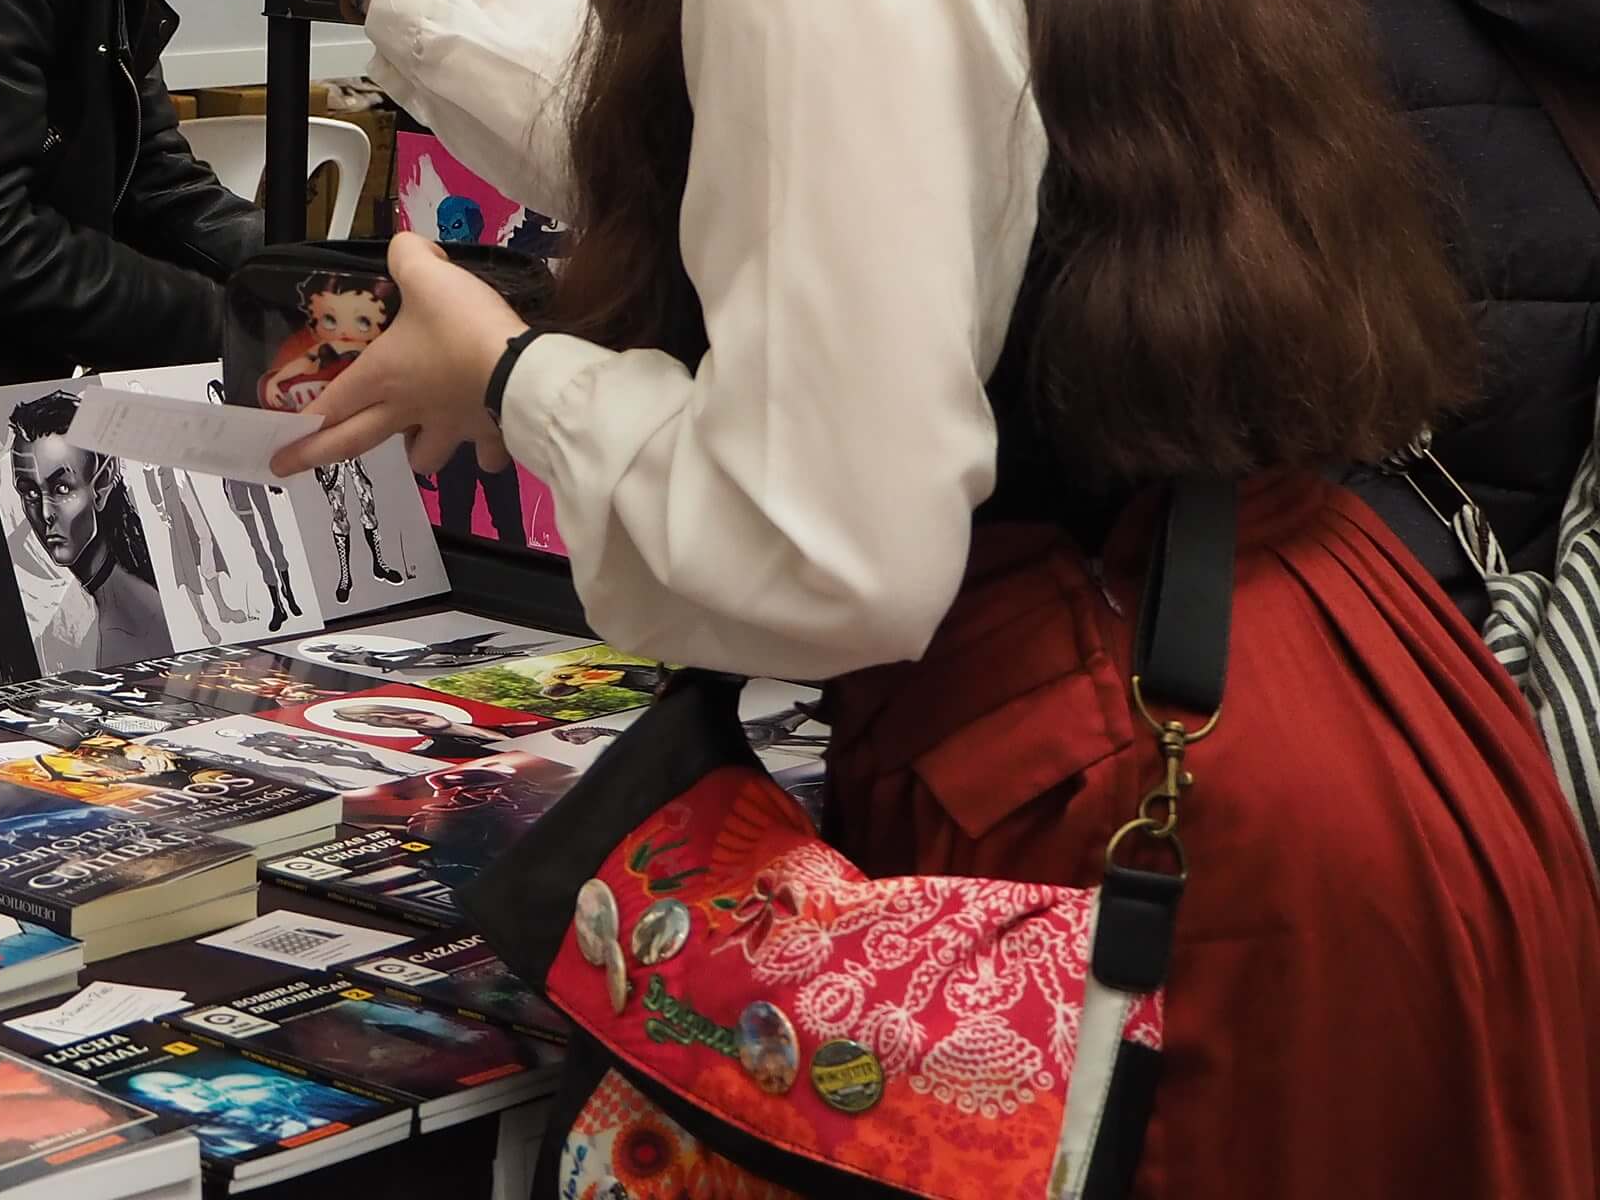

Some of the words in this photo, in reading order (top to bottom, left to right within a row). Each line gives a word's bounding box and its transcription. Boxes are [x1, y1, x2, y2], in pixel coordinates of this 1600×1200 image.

[303, 836, 367, 857] TROPAS
[365, 829, 392, 841] DE
[323, 837, 403, 863] CHOQUE
[232, 981, 310, 1008] SOMBRAS
[250, 980, 352, 1015] DEMONIACAS
[44, 1033, 131, 1064] LUCHA
[73, 1044, 150, 1071] FINAL
